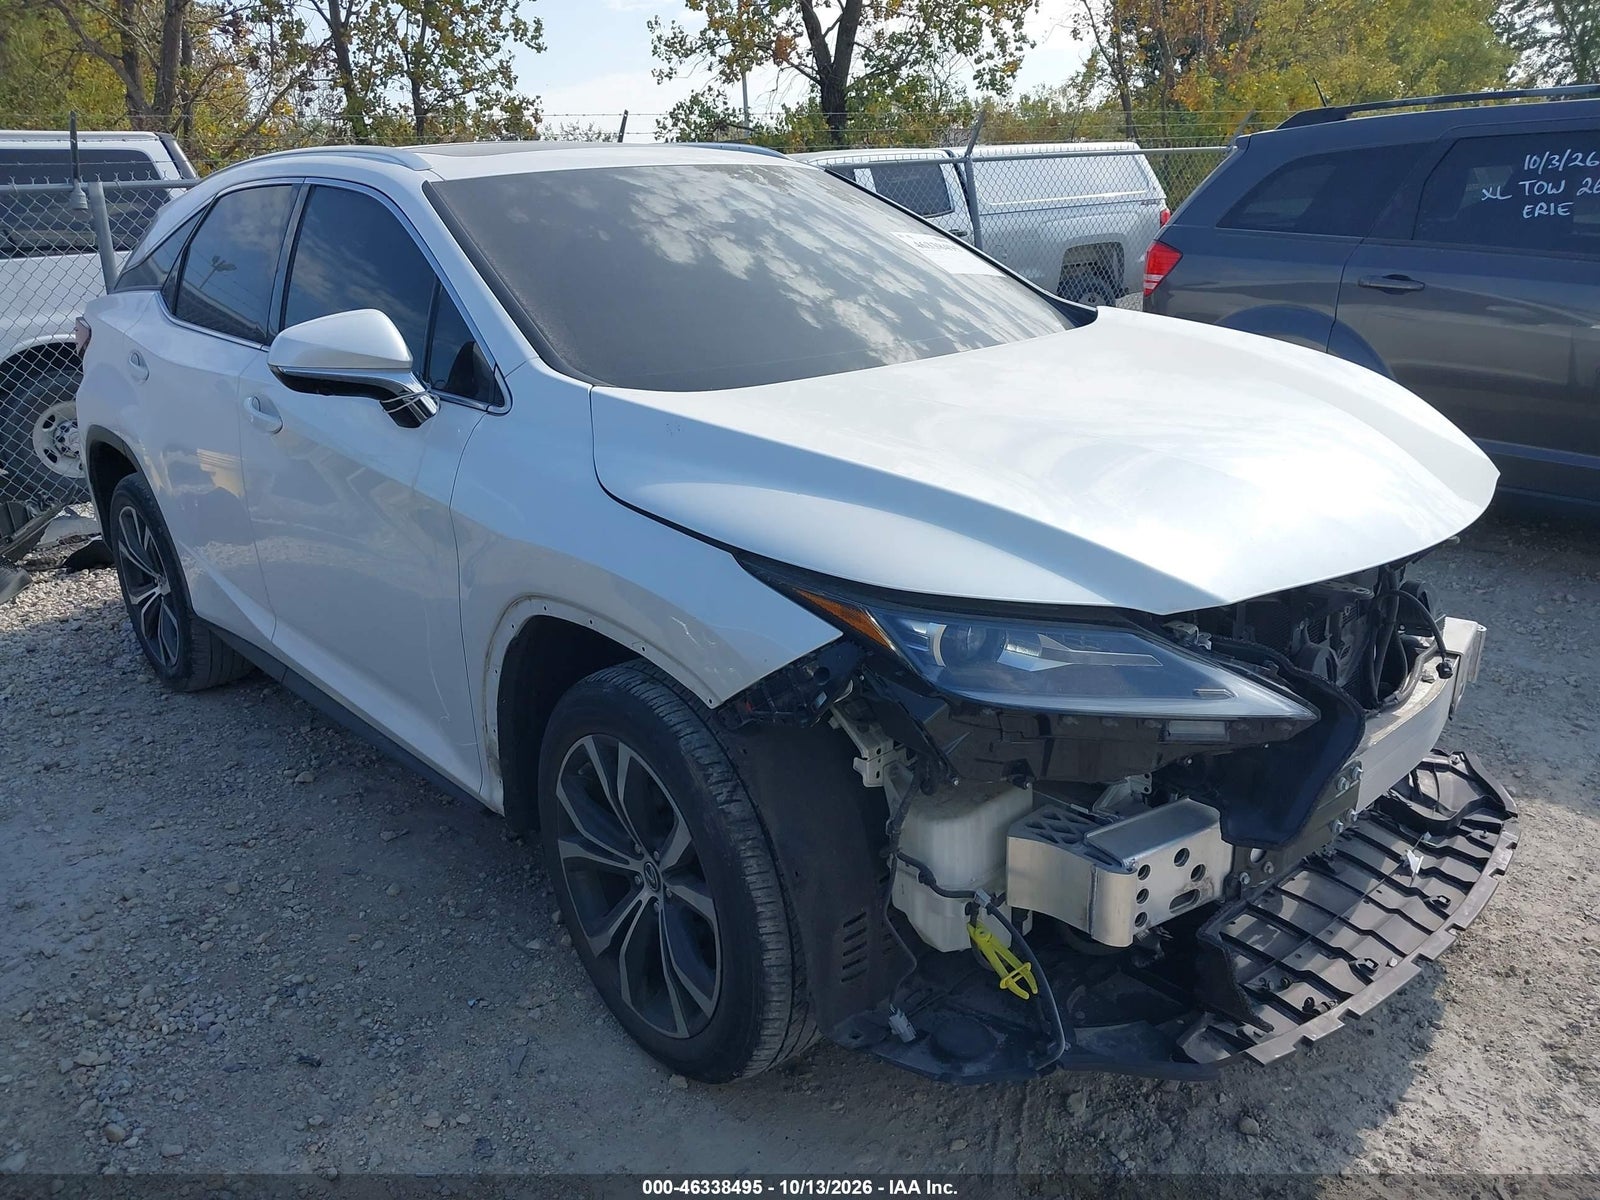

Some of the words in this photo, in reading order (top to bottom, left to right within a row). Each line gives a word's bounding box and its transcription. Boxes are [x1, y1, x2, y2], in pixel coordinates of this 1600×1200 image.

[1524, 149, 1600, 174] 10/3/26
[1481, 186, 1512, 201] XL
[1518, 180, 1566, 196] TOW
[1522, 202, 1574, 218] ERIE
